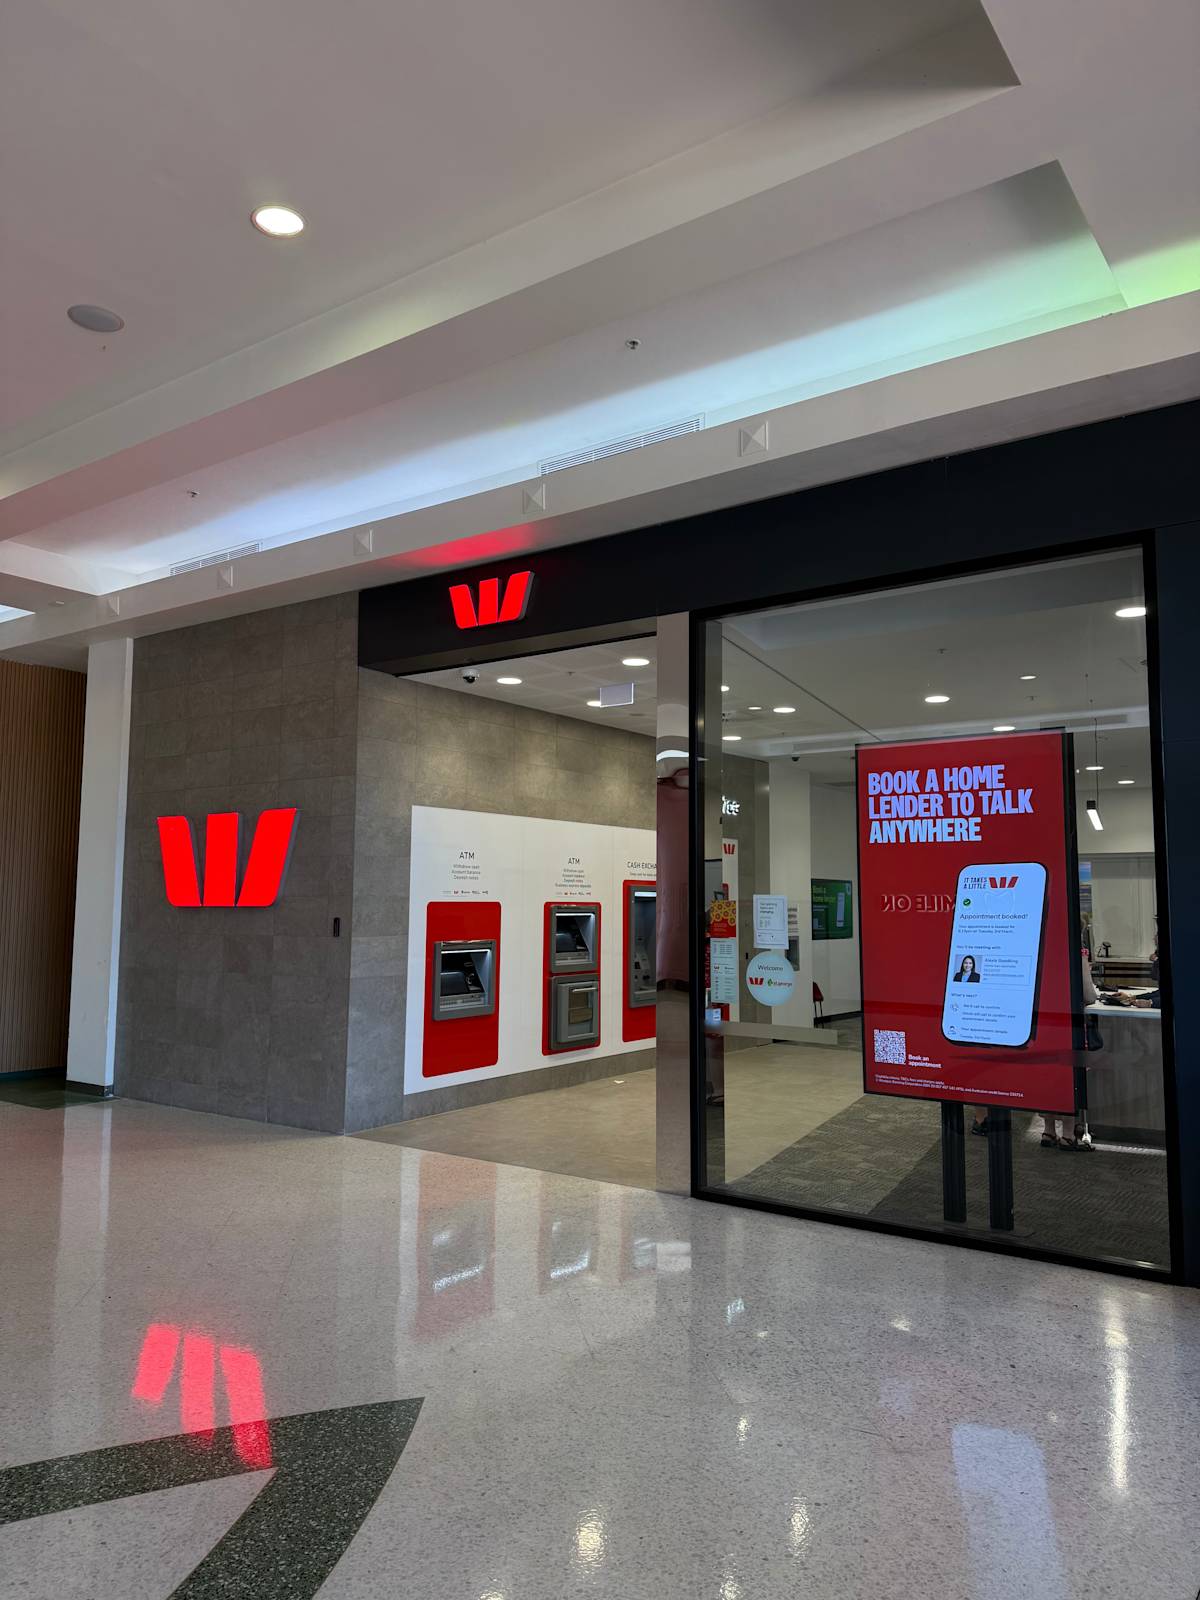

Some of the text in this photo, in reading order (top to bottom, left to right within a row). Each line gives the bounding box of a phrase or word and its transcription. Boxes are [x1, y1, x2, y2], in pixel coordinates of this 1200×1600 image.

[868, 764, 1006, 795] BOOK A HOME
[868, 788, 1034, 819] LENDER TO TALK
[869, 817, 982, 844] ANYWHERE
[459, 851, 475, 860] ATM
[567, 857, 580, 865] ATM
[627, 861, 641, 869] CASH
[908, 1061, 942, 1069] appointment
